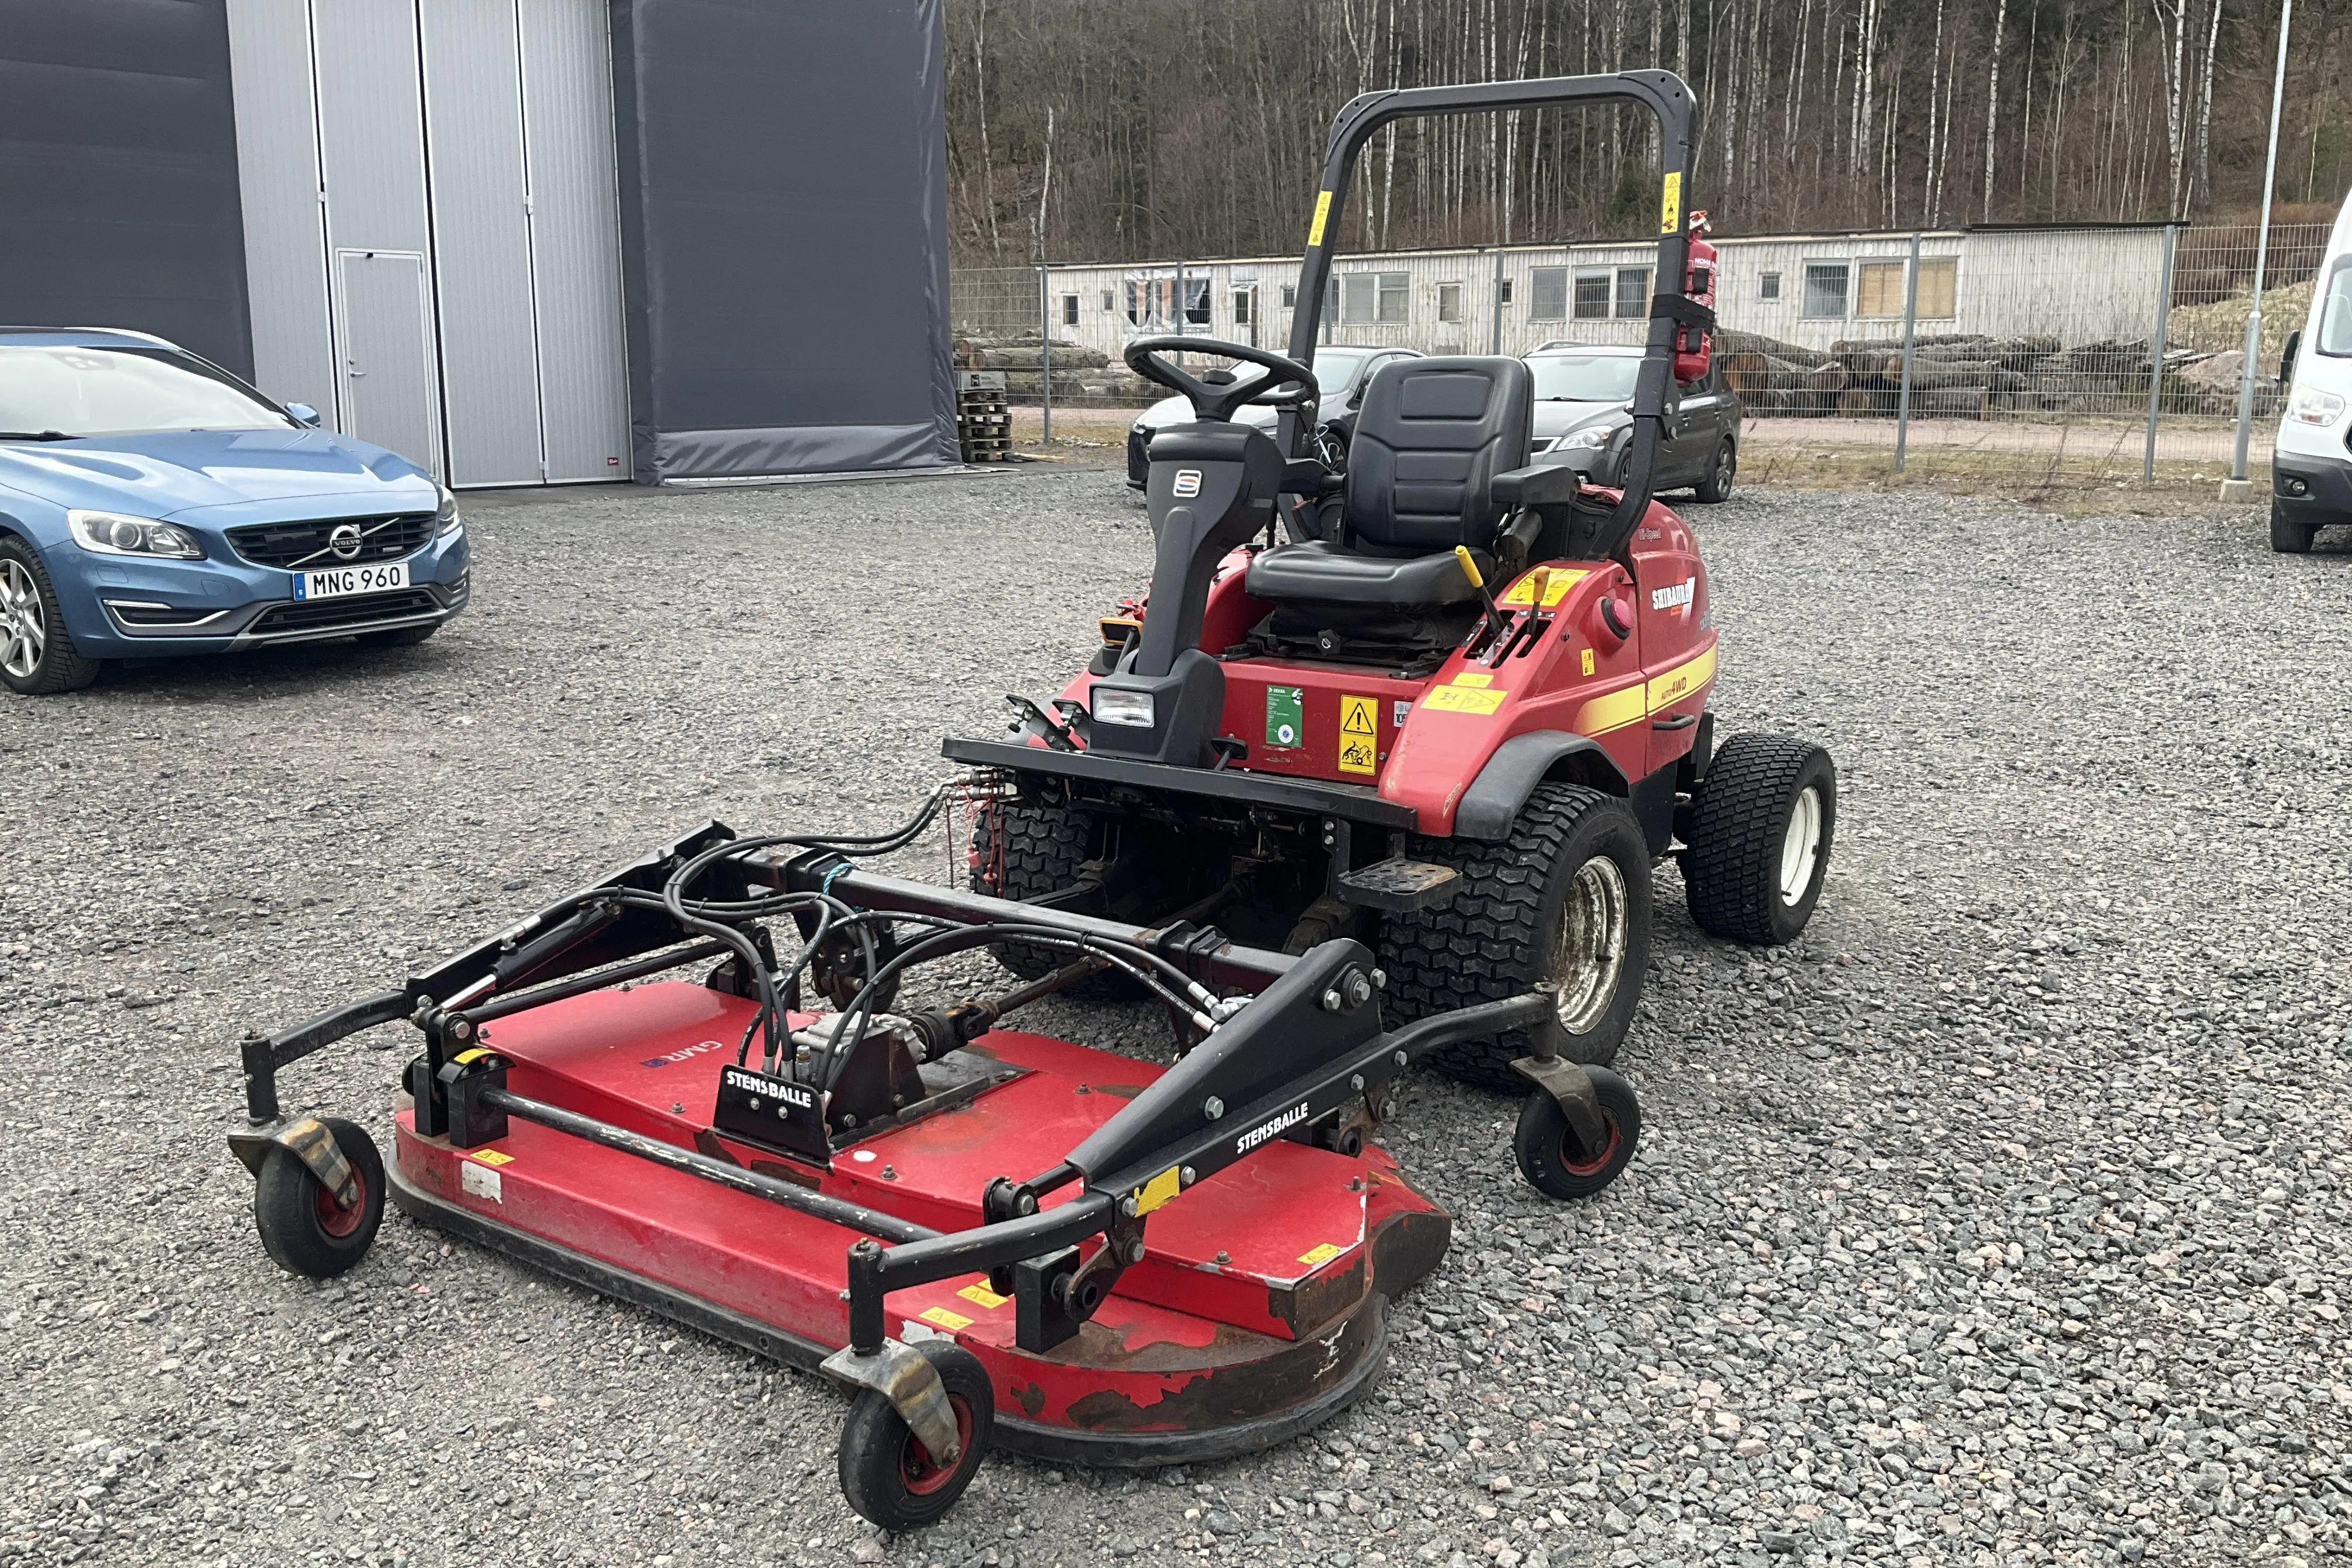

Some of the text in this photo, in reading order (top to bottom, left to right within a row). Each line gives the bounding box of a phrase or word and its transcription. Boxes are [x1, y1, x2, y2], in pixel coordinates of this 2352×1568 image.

[313, 566, 400, 595] MNG 960
[1652, 583, 1690, 610] SHIBAURA
[660, 1041, 723, 1061] GMR
[727, 1071, 811, 1108] STENSBALLE
[1237, 1102, 1308, 1154] STENSBALLE
